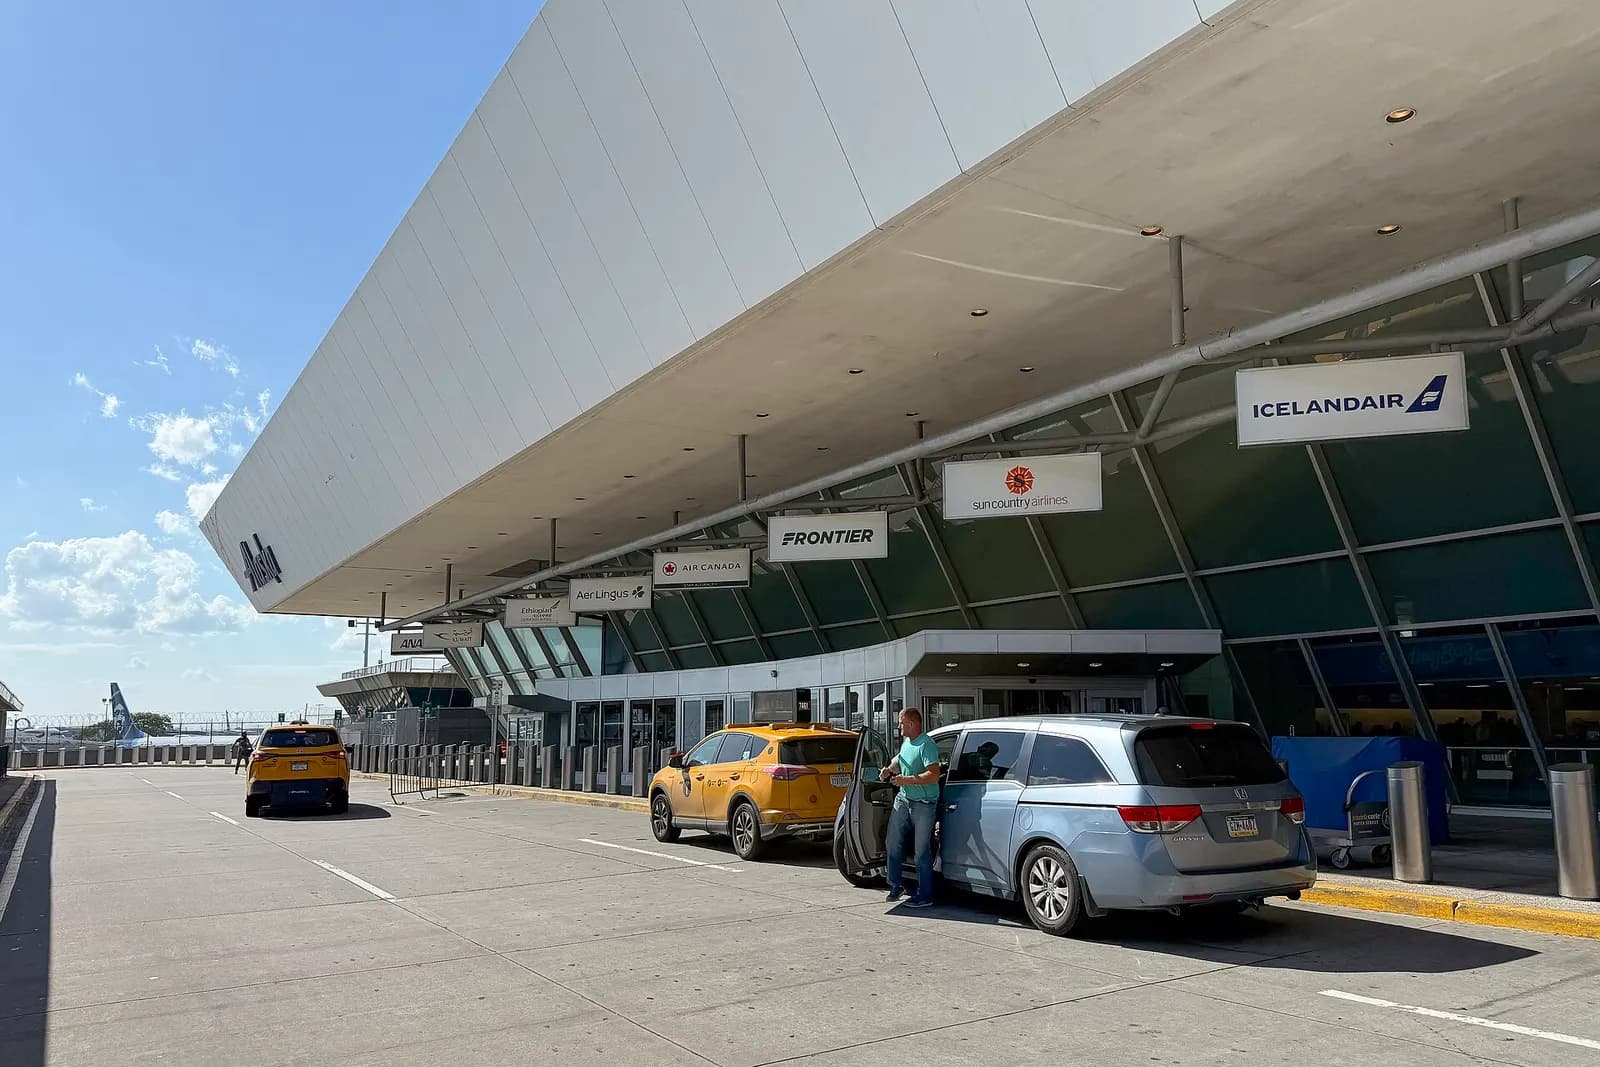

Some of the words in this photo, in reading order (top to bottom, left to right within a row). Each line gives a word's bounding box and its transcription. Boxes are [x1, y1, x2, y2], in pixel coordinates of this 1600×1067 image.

[1252, 393, 1405, 418] ICELANDAIR
[1031, 494, 1068, 507] airlines
[781, 528, 874, 546] FRONTIER
[682, 564, 698, 572] AIR
[700, 562, 742, 571] CANADA
[575, 591, 595, 600] Aer
[595, 589, 630, 601] Lingus
[520, 606, 553, 616] Ethiopian
[399, 638, 423, 649] ANA
